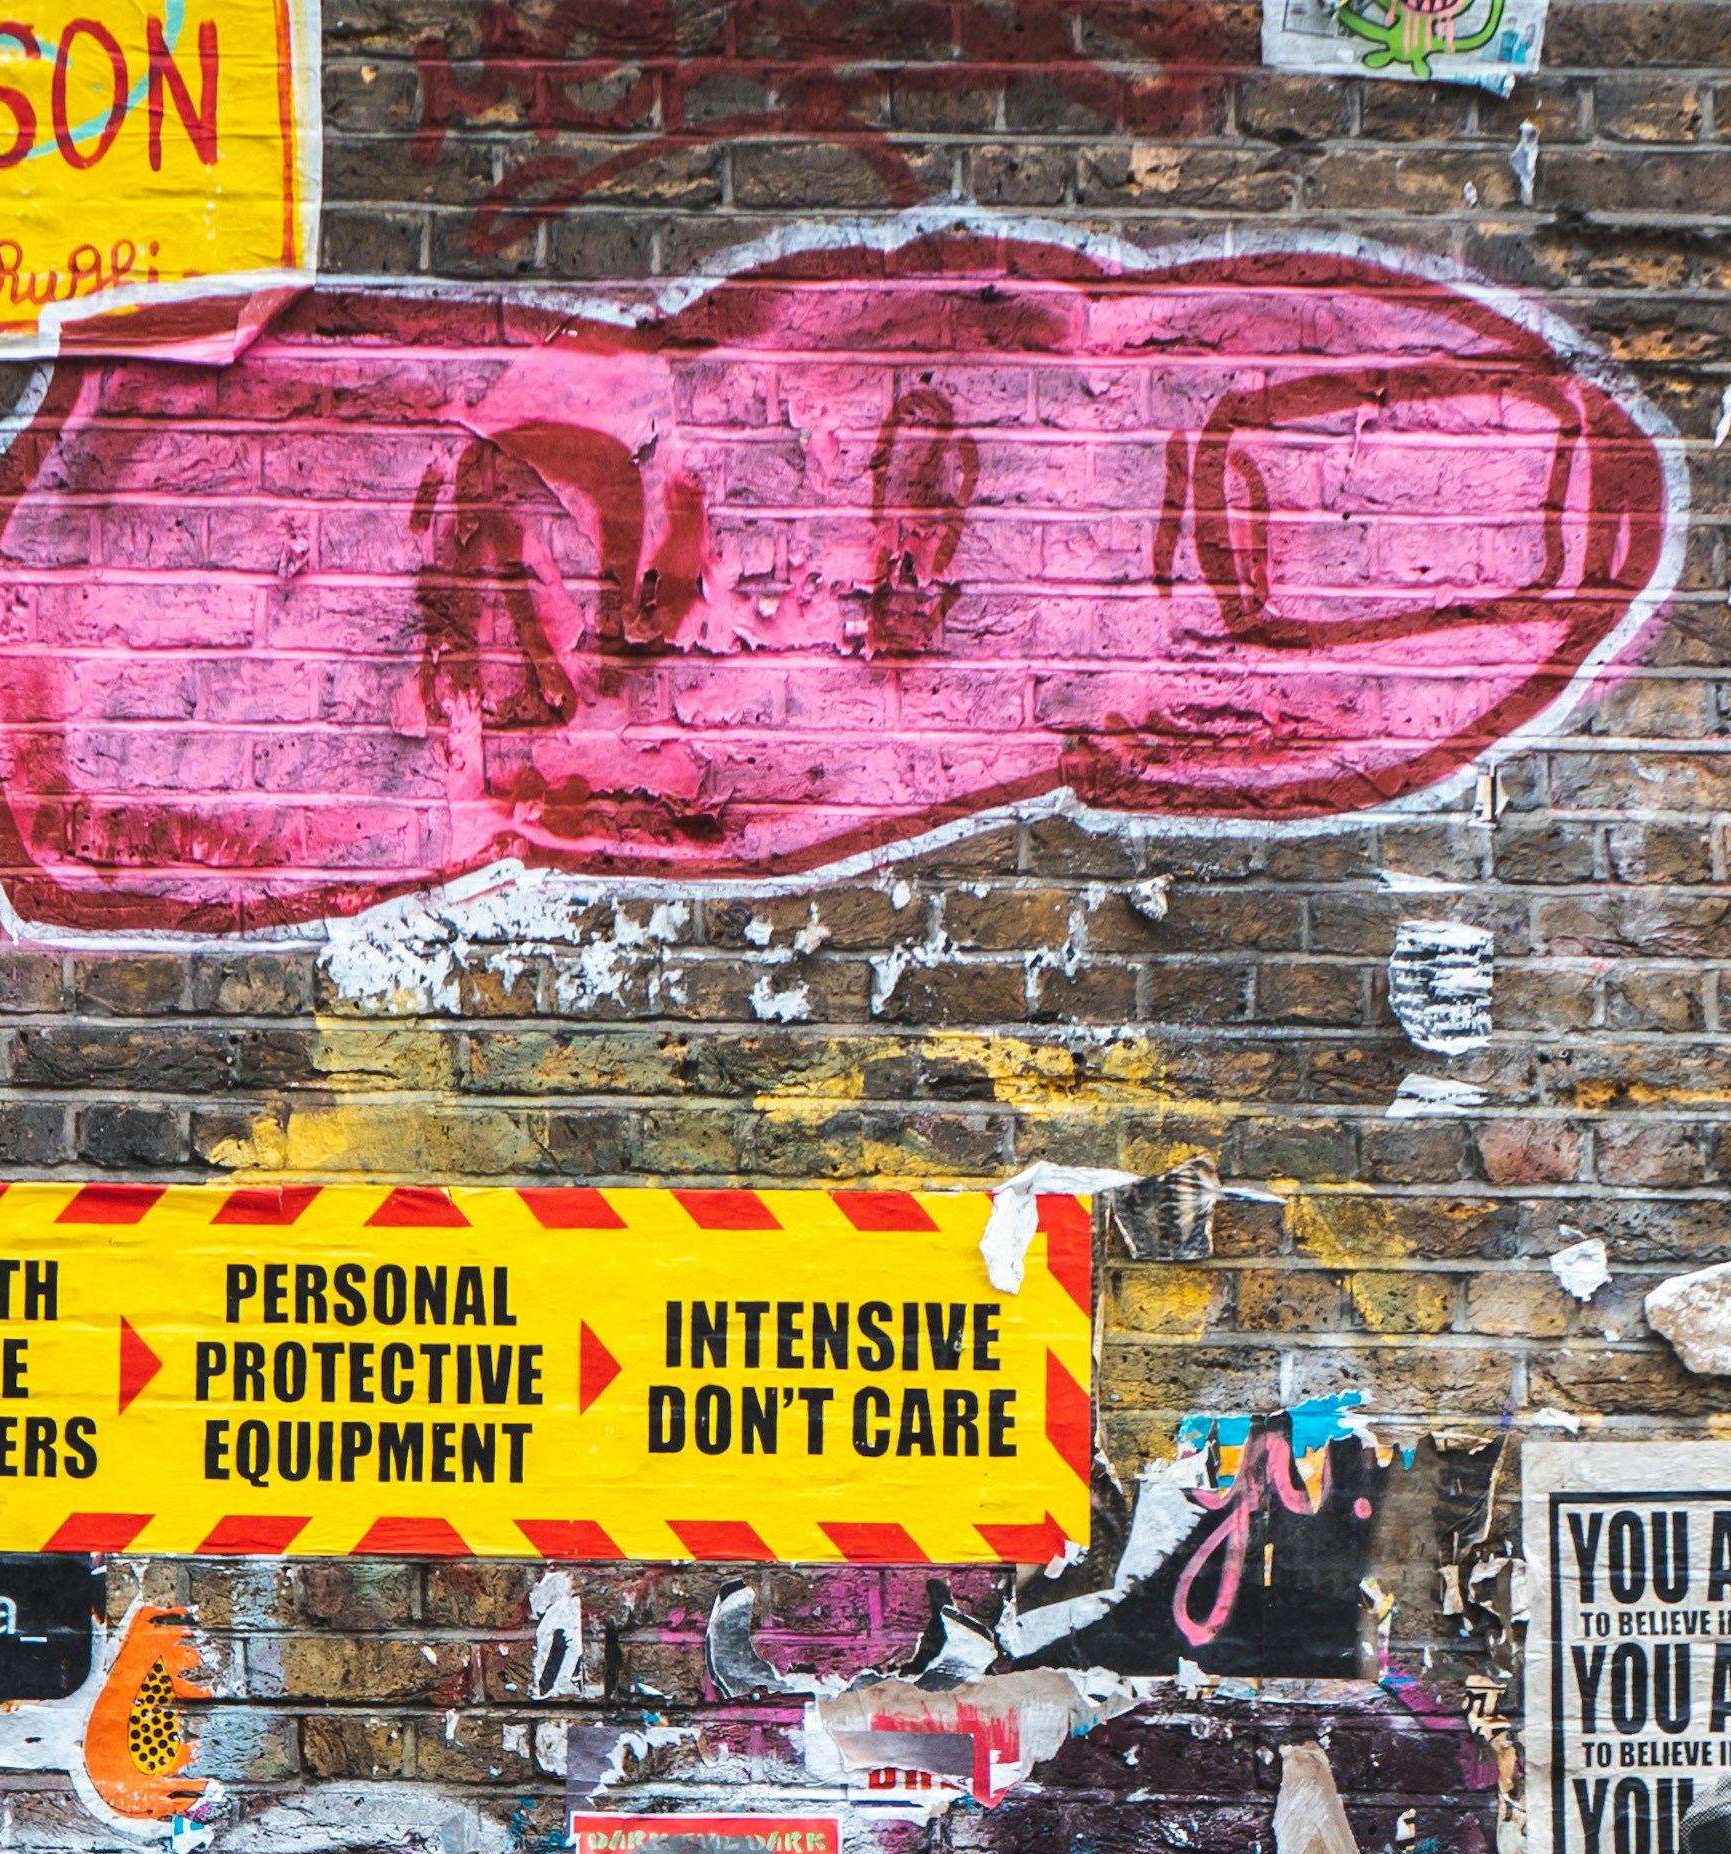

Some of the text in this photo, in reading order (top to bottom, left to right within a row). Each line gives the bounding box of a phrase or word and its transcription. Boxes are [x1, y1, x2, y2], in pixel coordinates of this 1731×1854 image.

[225, 1262, 517, 1326] PERSONAL
[665, 1299, 1002, 1372] INTENSIVE
[195, 1339, 543, 1405] PROTECTIVE
[204, 1419, 533, 1488] EQUIPMENT
[647, 1384, 1018, 1457] DON'T CARE
[1568, 1510, 1689, 1604] YOU
[1580, 1610, 1611, 1637] TO
[1618, 1608, 1711, 1637] BELIEVE
[1570, 1641, 1690, 1735] YOU
[1582, 1741, 1613, 1768] TO
[1619, 1740, 1712, 1767] BELIEVE
